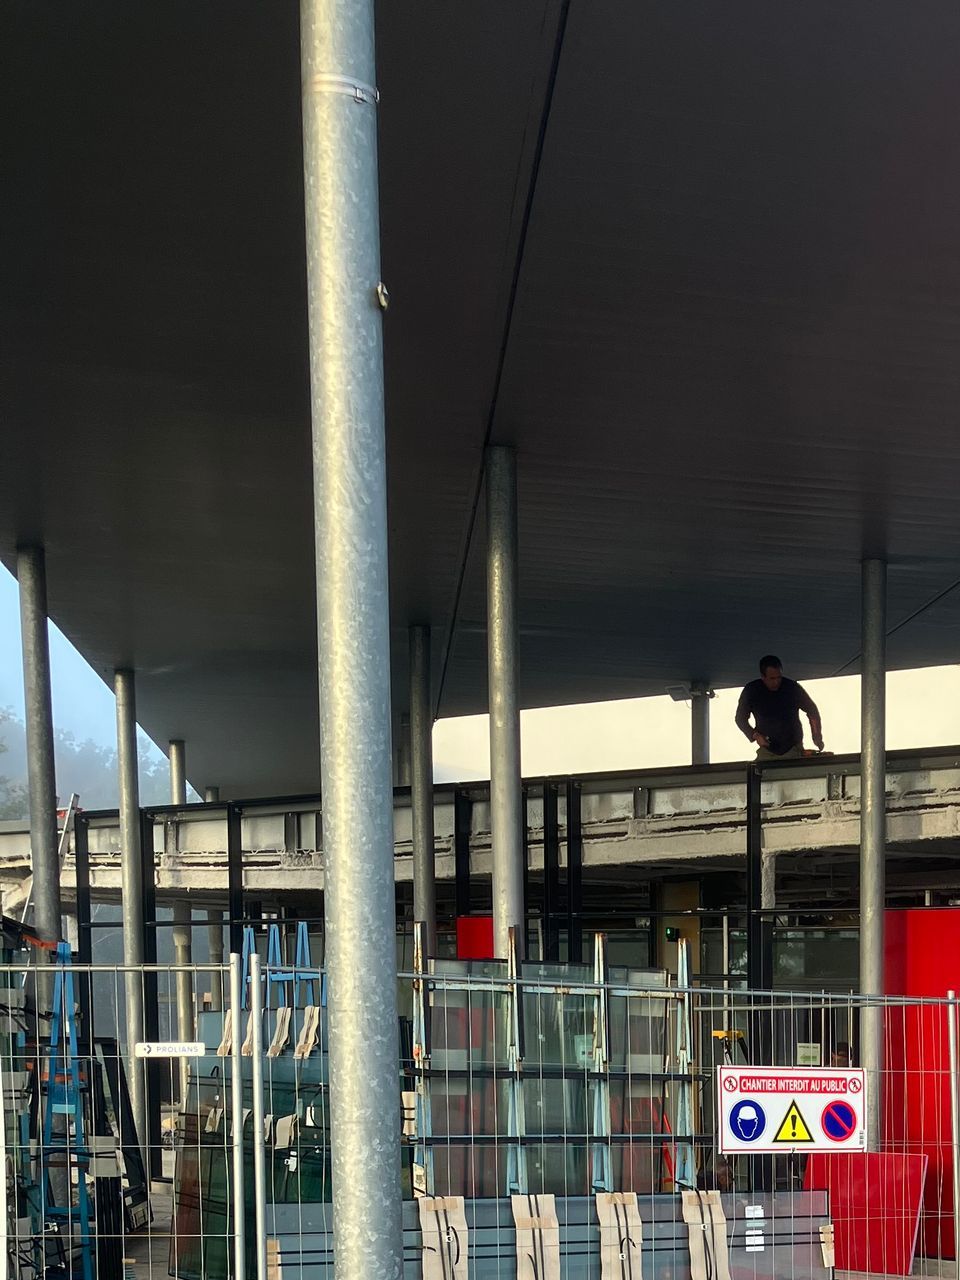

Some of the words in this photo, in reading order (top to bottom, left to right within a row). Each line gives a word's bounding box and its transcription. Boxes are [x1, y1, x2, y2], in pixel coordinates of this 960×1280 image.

[741, 1078, 777, 1091] CHANTIER
[778, 1079, 810, 1092] INTERDIT
[810, 1080, 821, 1092] AU
[821, 1080, 846, 1092] PUBLIC
